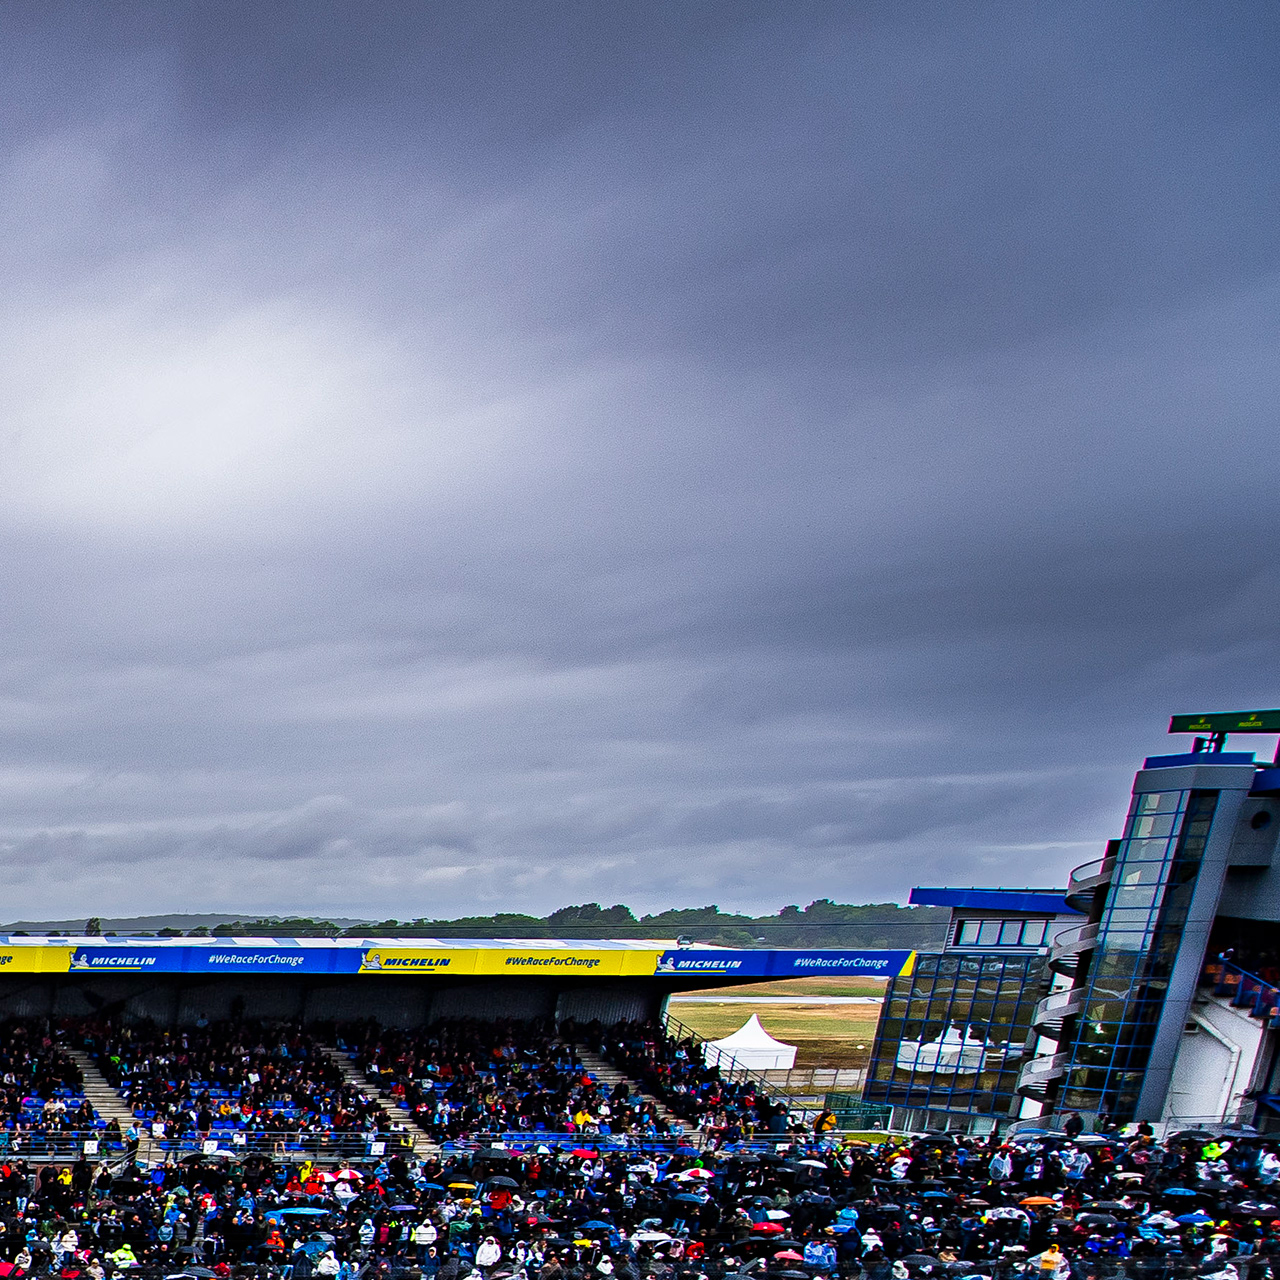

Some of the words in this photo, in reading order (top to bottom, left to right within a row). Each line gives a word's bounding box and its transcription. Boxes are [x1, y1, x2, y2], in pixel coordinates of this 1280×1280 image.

[91, 957, 156, 966] MICHELIN
[209, 955, 304, 966] #WeRaceForChange
[506, 957, 600, 968] #WeRaceForChange
[676, 960, 742, 969] MICHELIN
[795, 958, 888, 968] #WeRaceForChange
